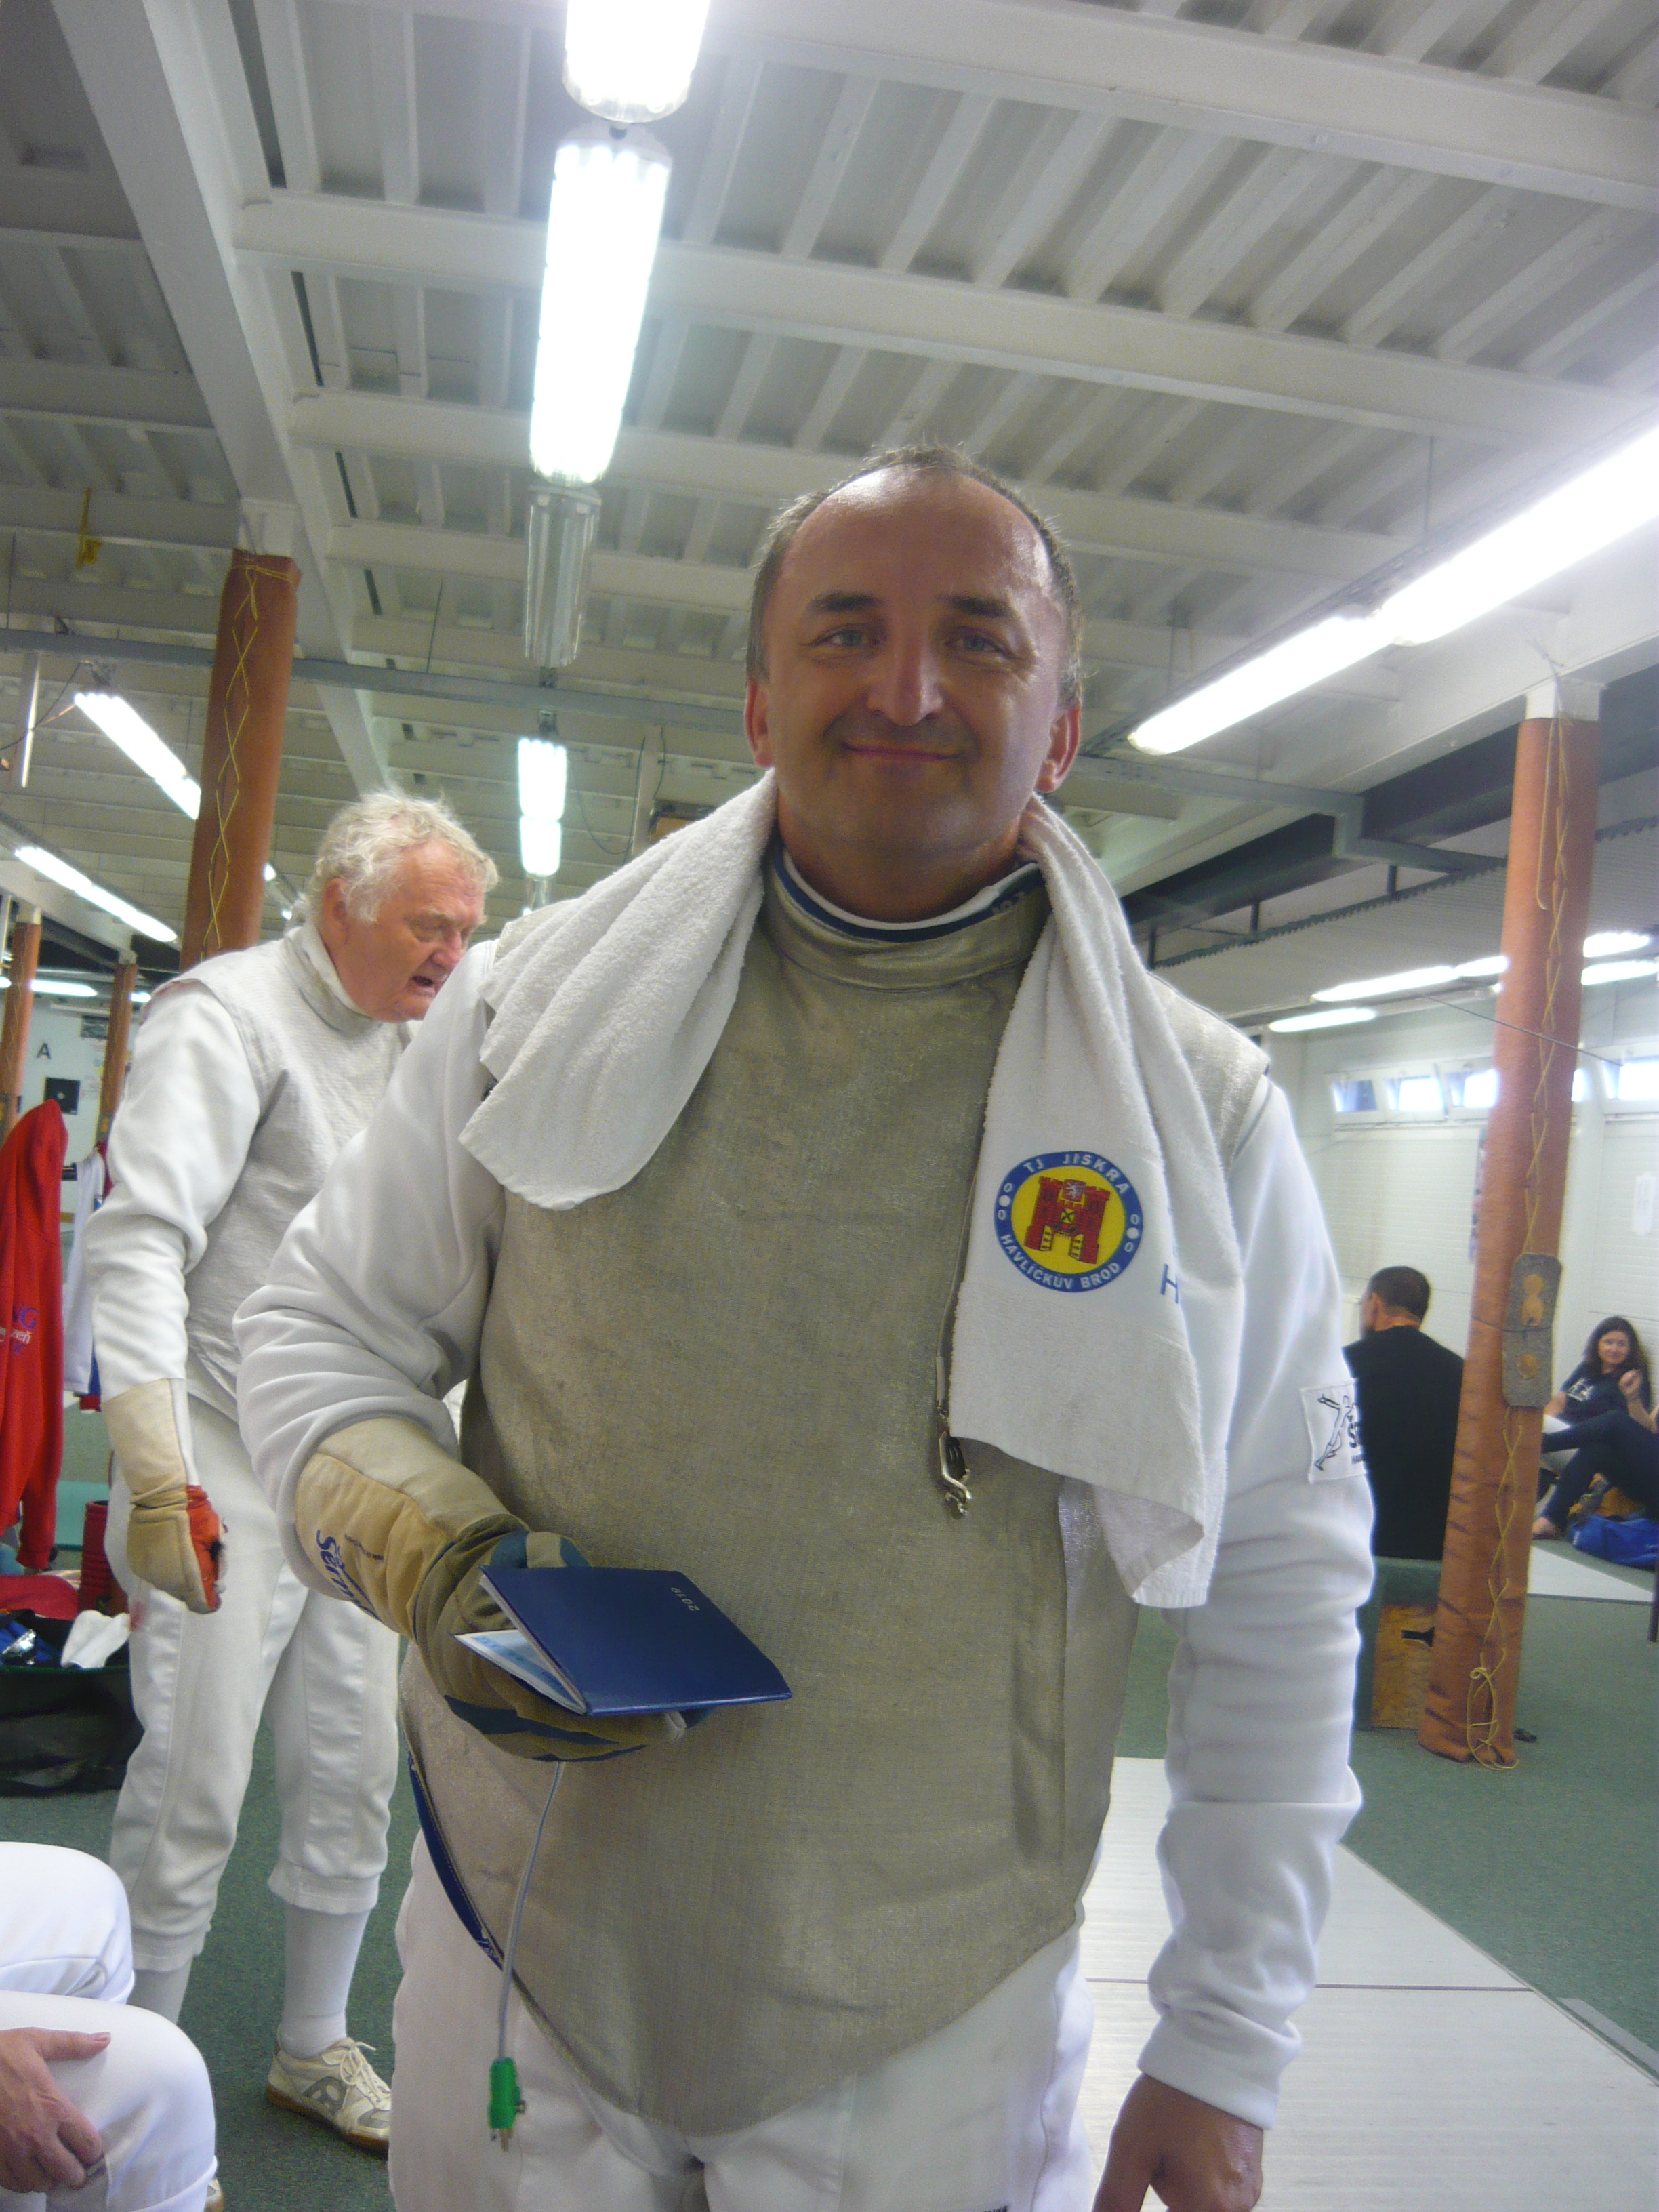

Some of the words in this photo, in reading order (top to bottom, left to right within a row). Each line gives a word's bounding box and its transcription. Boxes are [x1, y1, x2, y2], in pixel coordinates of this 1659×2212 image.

[36, 1042, 52, 1060] A
[1023, 1158, 1044, 1174] TJ
[1062, 1153, 1130, 1194] JISKRA
[1080, 1262, 1120, 1288] BROD
[670, 1587, 700, 1611] 2019
